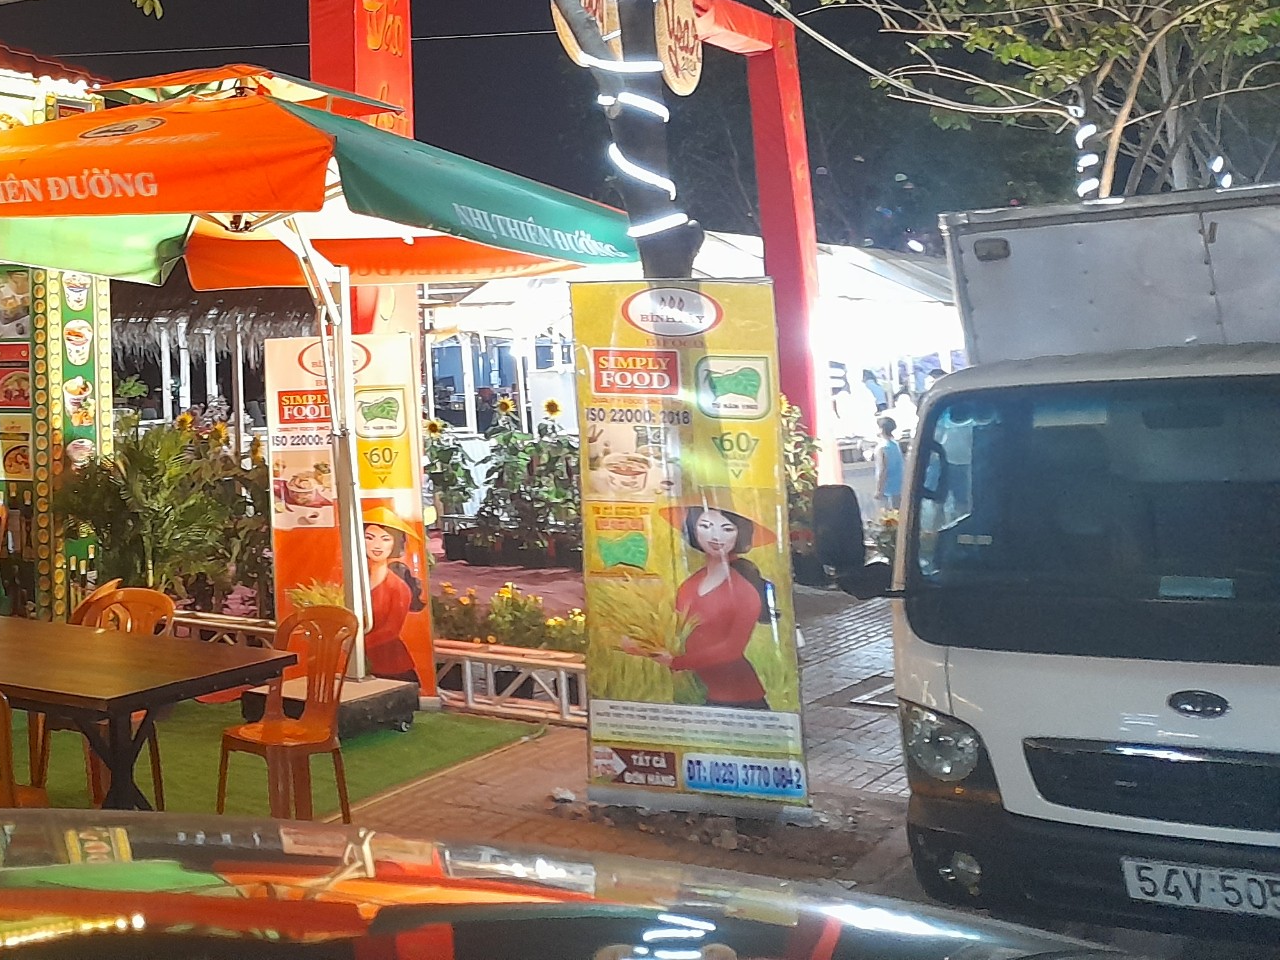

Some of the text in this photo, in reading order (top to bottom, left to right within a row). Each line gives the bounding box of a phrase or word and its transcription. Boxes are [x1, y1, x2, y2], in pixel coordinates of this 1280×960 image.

[47, 167, 158, 201] ĐƯỜNG
[452, 203, 630, 258] NHỊ THIÊN ĐƯỜNG
[640, 312, 705, 324] BÌNHY
[598, 355, 670, 371] SIMPLY
[600, 370, 671, 390] FOOD
[586, 408, 606, 422] ISO
[660, 410, 691, 425] 2018
[272, 435, 289, 446] ISO
[720, 431, 751, 452] 60
[369, 447, 393, 464] 60
